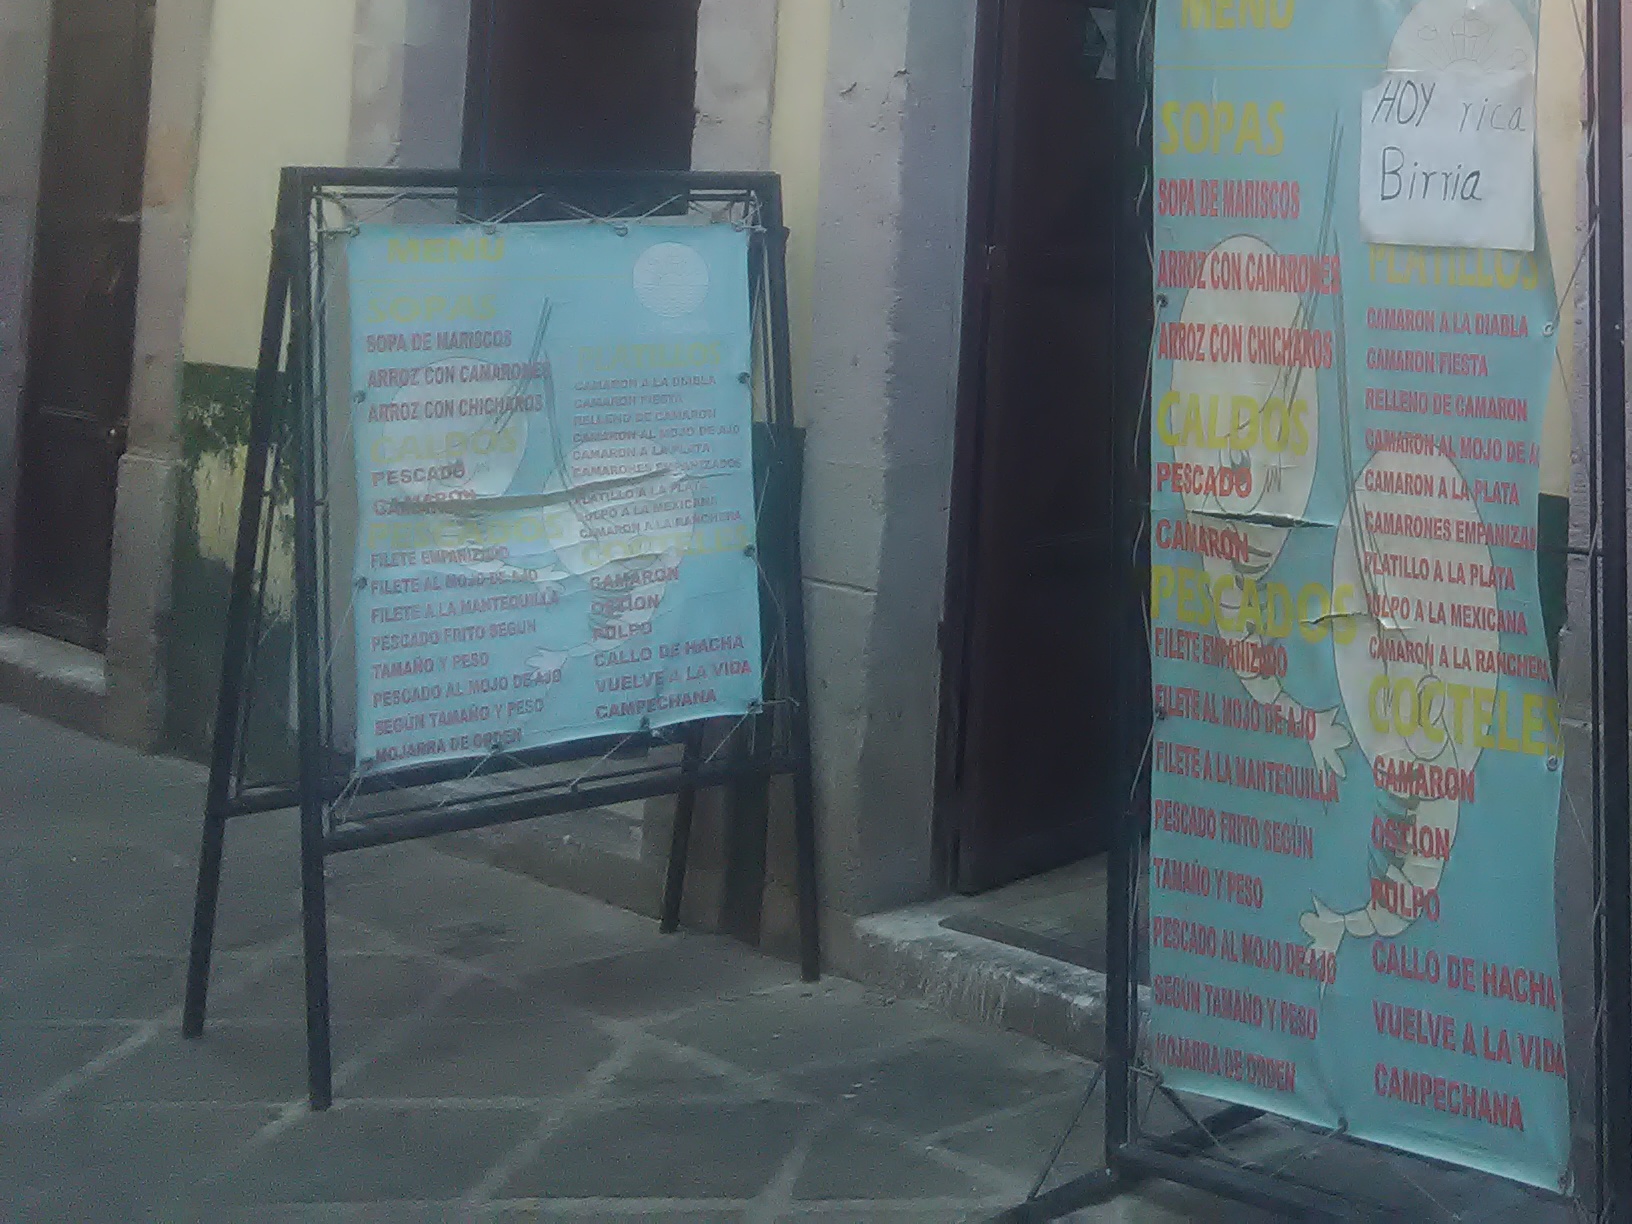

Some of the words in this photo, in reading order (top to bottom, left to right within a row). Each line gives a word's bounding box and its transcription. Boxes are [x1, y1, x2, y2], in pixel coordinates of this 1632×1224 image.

[1370, 79, 1436, 128] HOY
[1459, 98, 1527, 133] rica
[1159, 101, 1286, 156] SOPAS
[1380, 146, 1483, 204] Birria
[1158, 178, 1196, 216] SOPA
[1200, 179, 1219, 216] DE
[1222, 180, 1300, 219] MARISCOS
[1158, 250, 1206, 289] ARROZ
[1210, 251, 1241, 290] CON
[1246, 252, 1341, 295] CAMARONES
[1369, 243, 1539, 291] PLATILLOS
[367, 293, 497, 323] SOPAS
[1366, 307, 1436, 333] CAMARON
[1439, 311, 1449, 333] A
[1453, 312, 1472, 335] LA
[1475, 313, 1529, 338] DIABLA
[366, 333, 407, 354] SOPA
[411, 332, 432, 351] DE
[436, 329, 512, 350] MARISCOS
[577, 341, 722, 372] PLATILLOS
[1158, 322, 1206, 361] ARROZ
[1209, 324, 1243, 362] CON
[1247, 326, 1333, 369] CHICHAROS
[367, 367, 420, 389] ARROZ
[424, 364, 454, 385] CON
[459, 361, 551, 383] CAMARONES
[1366, 347, 1435, 373] CAMARON
[1439, 352, 1488, 376] FIESTA
[368, 401, 420, 423] ARROZ
[424, 399, 454, 419] CON
[458, 393, 545, 417] CHICHAROS
[1365, 387, 1428, 415] RELLENO
[1432, 393, 1451, 416] DE
[1455, 394, 1528, 421] CAMARON
[1156, 391, 1310, 456] CALDOS
[370, 427, 517, 464] CALDOS
[572, 446, 636, 460] CAMARON
[1365, 427, 1434, 456] CAMARON
[1437, 434, 1456, 459] AL
[1460, 435, 1502, 462] MOJO
[1506, 440, 1526, 464] DE
[371, 459, 465, 487] PESCADO
[1156, 462, 1253, 498] PESCADO
[1364, 468, 1434, 498] CAMARON
[1437, 477, 1448, 499] A
[1451, 478, 1470, 502] LA
[1474, 479, 1520, 506] PLATA
[1364, 510, 1451, 542] CAMARONES
[370, 550, 417, 569] FILETE
[1364, 551, 1430, 581] PLATILLO
[1433, 559, 1444, 582] A
[1447, 561, 1466, 585] LA
[1470, 564, 1516, 591] PLATA
[371, 578, 419, 595] FILETE
[424, 576, 442, 591] AL
[589, 566, 679, 591] CAMARON
[371, 605, 421, 624] FILETE
[438, 601, 455, 617] LA
[1151, 565, 1357, 645] PESCADOS
[1414, 599, 1425, 622] A
[1428, 601, 1446, 625] LA
[1451, 604, 1528, 636] MEXICANA
[370, 630, 440, 652] PESCADO
[443, 625, 486, 644] FRITO
[591, 622, 653, 642] PULPO
[372, 654, 434, 680] TAMAÑO
[452, 651, 490, 669] PESO
[594, 646, 653, 667] CALLO
[659, 641, 680, 659] DE
[684, 635, 745, 654] HACHA
[1155, 627, 1200, 663] FILETE
[1203, 635, 1288, 677] EMPANIZADO
[1368, 635, 1434, 667] CAMARON
[1438, 643, 1449, 669] A
[1453, 644, 1471, 671] LA
[372, 684, 441, 708] PESCADO
[445, 680, 463, 699] AL
[468, 676, 508, 696] MOJO
[512, 672, 530, 689] DE
[534, 668, 562, 687] AJO
[595, 668, 665, 692] VUELVE
[686, 664, 708, 681] LA
[714, 660, 752, 676] VIDA
[429, 704, 490, 728] TAMAÑO
[506, 697, 544, 717] PESO
[595, 688, 717, 719] CAMPECHANA
[1155, 684, 1200, 720] FILETE
[1202, 691, 1220, 725] AL
[1222, 697, 1260, 732] MOJO
[1264, 703, 1283, 735] DE
[1287, 707, 1317, 742] AJO
[1369, 675, 1565, 757] COCTELES
[375, 738, 446, 764] MOJARRA
[450, 733, 468, 752] DE
[1155, 741, 1200, 779] FILETE
[1202, 749, 1213, 782] A
[1216, 752, 1233, 786] LA
[1236, 756, 1340, 803] MANTEQUILLA
[1373, 755, 1475, 803] CAMARON
[1154, 799, 1216, 840] PESCADO
[1220, 809, 1260, 849] FRITO
[1371, 815, 1450, 862] OSTION
[1153, 857, 1211, 898] TAMAÑO
[1215, 868, 1225, 901] Y
[1226, 870, 1264, 909] PESO
[1371, 876, 1440, 922] PULPO
[1153, 916, 1217, 959] PESCADO
[1220, 929, 1239, 963] AL
[1241, 932, 1282, 973] MOJO
[1286, 942, 1306, 978] DE
[1306, 947, 1337, 985] AJO
[1372, 939, 1440, 984] CALLO
[1447, 954, 1476, 993] DE
[1482, 961, 1557, 1011] HACHA
[1204, 984, 1262, 1027] TAMAÑO
[1267, 997, 1278, 1031] Y
[1281, 1000, 1319, 1040] PESO
[1372, 999, 1456, 1051] VUELVE
[1462, 1022, 1477, 1057] A
[1482, 1026, 1512, 1064] LA
[1517, 1032, 1567, 1079] VIDA
[1154, 1032, 1220, 1075] MOJARRA
[1222, 1045, 1243, 1081] DE
[1247, 1052, 1297, 1093] ORDEN
[1374, 1062, 1524, 1132] CAMPECHANA
